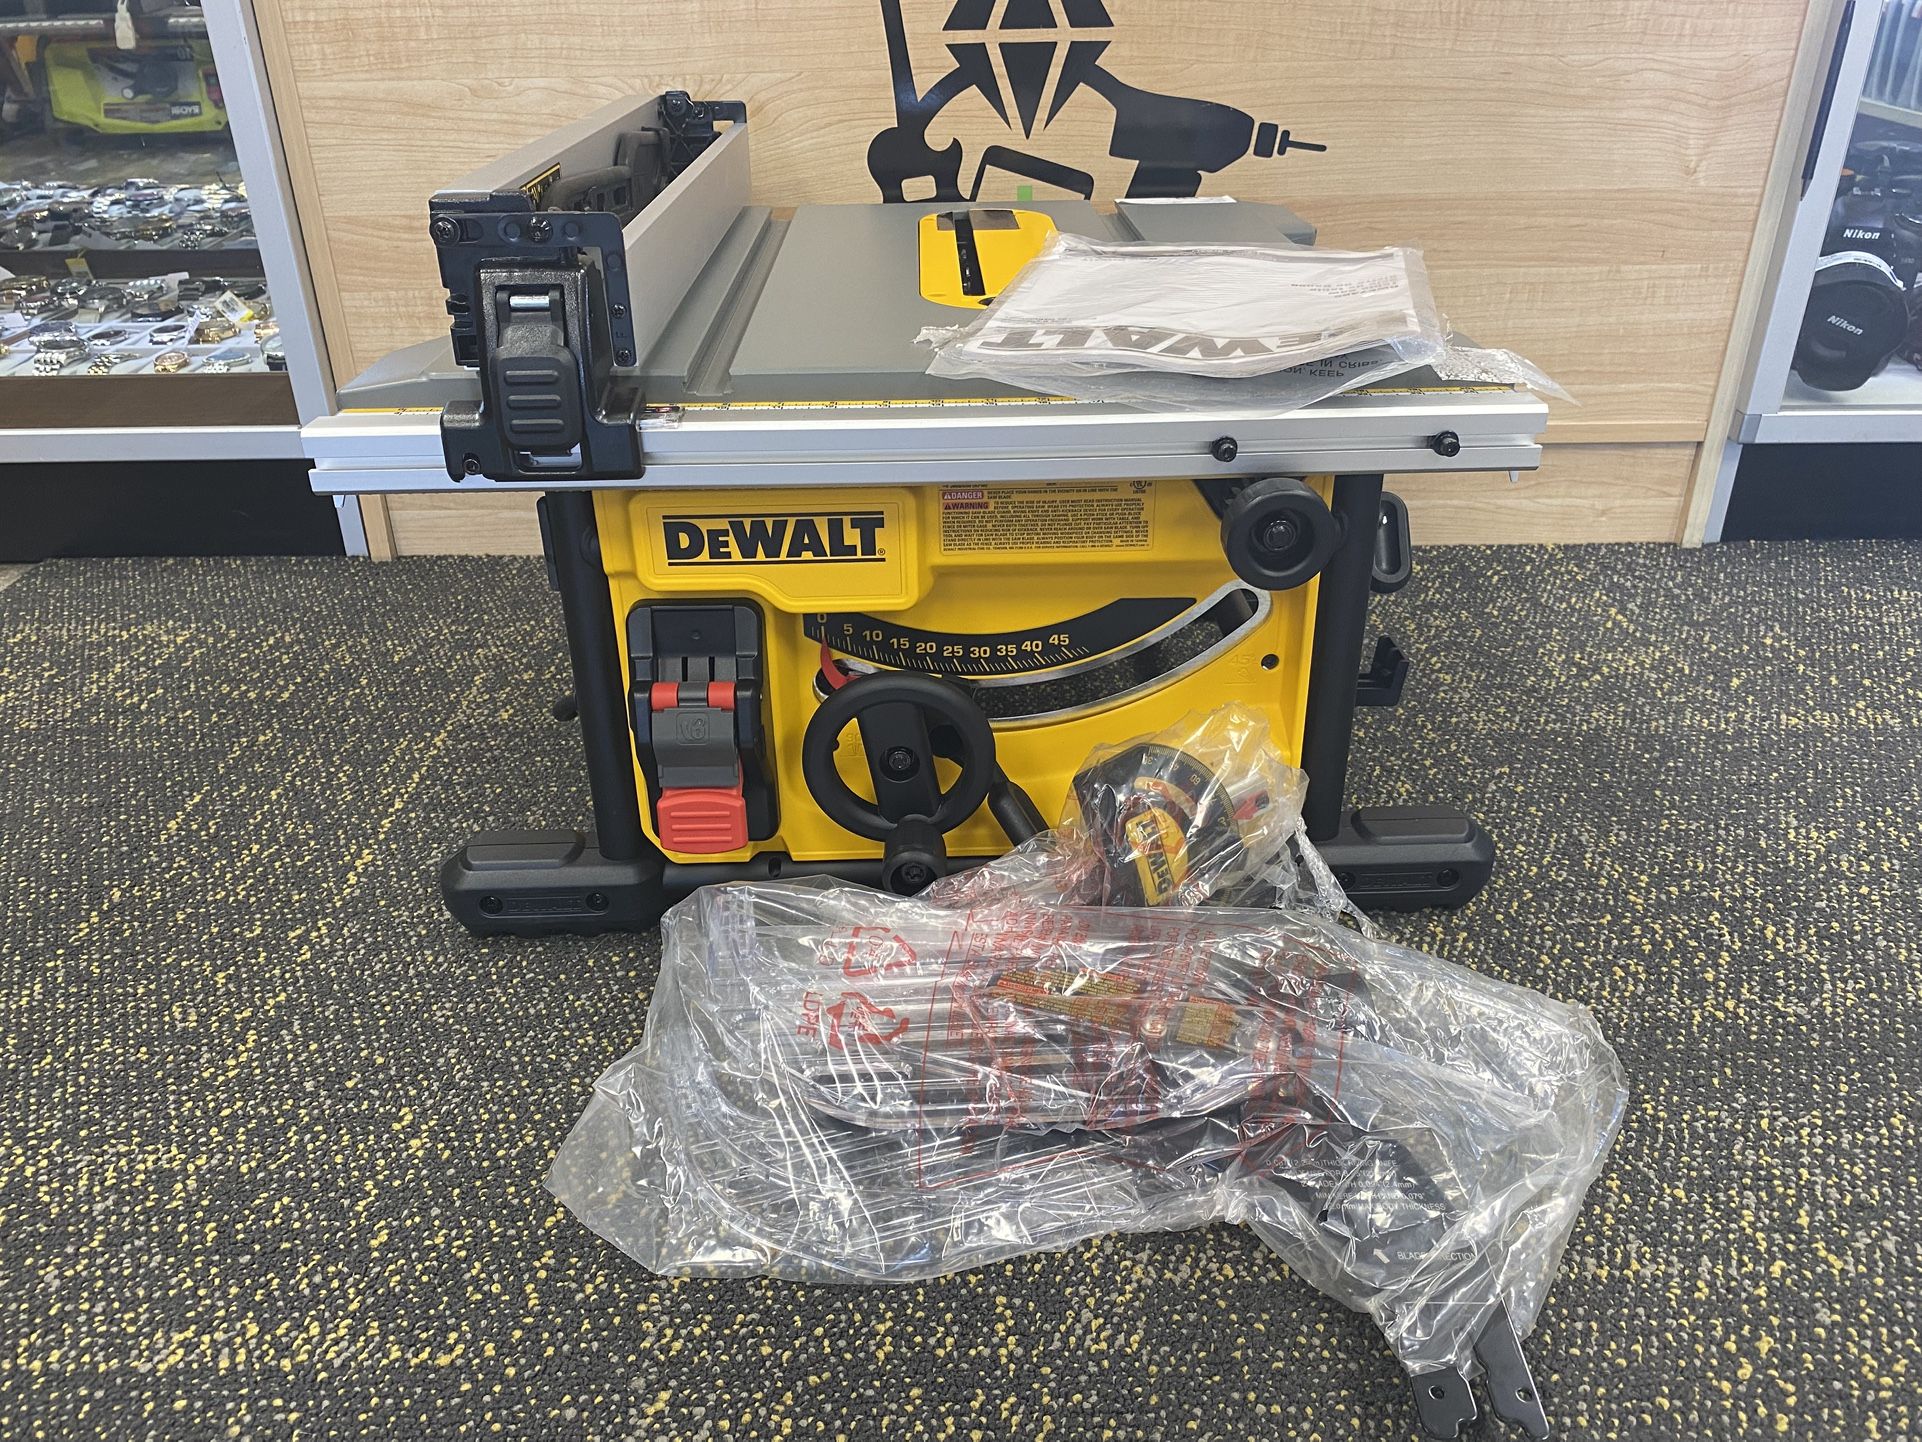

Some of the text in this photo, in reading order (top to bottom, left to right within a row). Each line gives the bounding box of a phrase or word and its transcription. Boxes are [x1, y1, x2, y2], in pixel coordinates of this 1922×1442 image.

[1843, 228, 1881, 240] Nikon
[1827, 314, 1864, 336] Nikon
[662, 516, 886, 561] DEWALT
[816, 613, 1070, 658] 0 5 10 15 20 25 30 35 40 45
